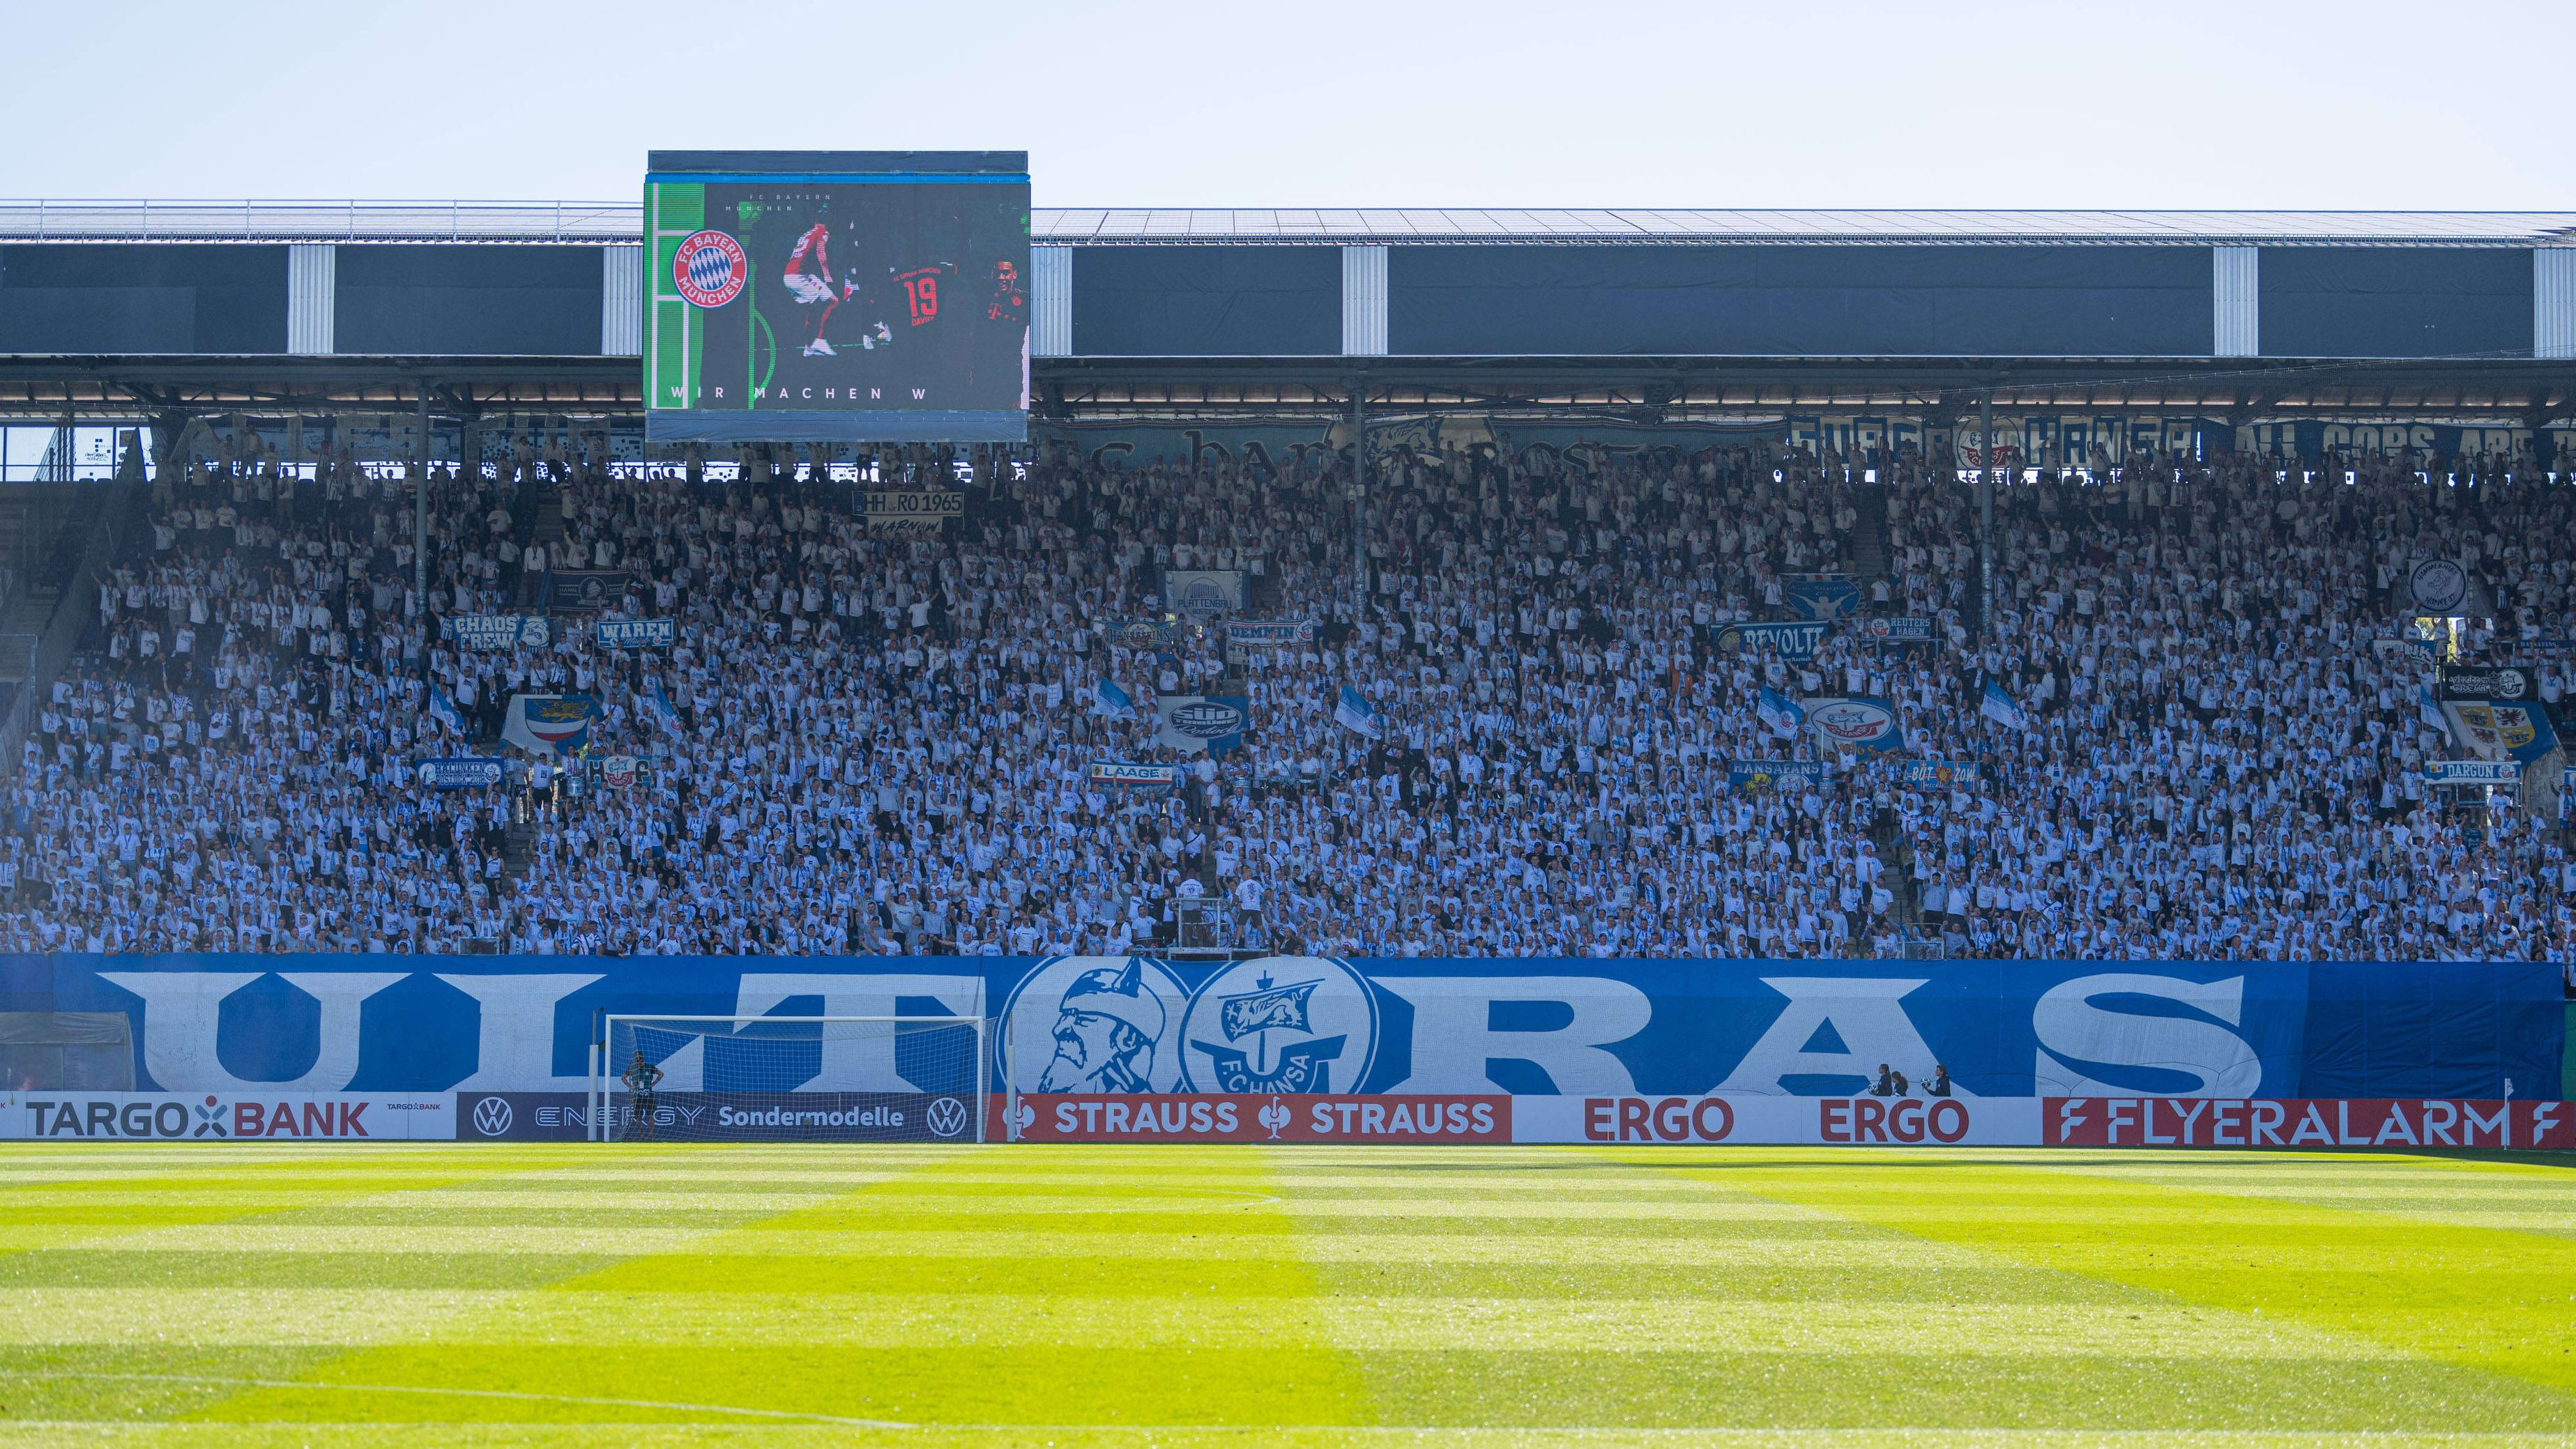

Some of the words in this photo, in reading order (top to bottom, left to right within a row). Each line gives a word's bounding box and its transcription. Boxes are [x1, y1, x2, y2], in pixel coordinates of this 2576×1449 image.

[678, 245, 694, 263] FC
[693, 234, 742, 263] BAYERN
[904, 276, 938, 317] 19
[671, 387, 724, 398] WIR
[754, 387, 881, 399] MACHEN
[911, 388, 926, 399] W
[2322, 424, 2436, 468] COPS
[864, 494, 886, 512] HH
[897, 494, 919, 512] RO
[922, 493, 962, 512] 1965
[1177, 598, 1233, 608] PLATTENBAU
[455, 616, 517, 633] CHAOS
[601, 622, 671, 638] WAREN
[1891, 617, 1930, 627] REUTERS
[1896, 627, 1925, 636] HAGEN
[460, 633, 515, 650] CREW
[1173, 707, 1237, 721] SÜD
[1172, 723, 1244, 737] Rostock
[434, 762, 486, 774] HALUNKEN
[1104, 767, 1159, 779] LAAGE
[2447, 764, 2494, 778] DARGUN
[535, 1105, 706, 1126] ENERGY
[719, 1105, 904, 1126] Sondermodelle
[1054, 1101, 1239, 1133] STRAUSS
[1311, 1103, 1495, 1135] STRAUSS
[1584, 1098, 1735, 1142] ERGO
[1820, 1099, 1970, 1142] ERGO
[2108, 1099, 2511, 1145] FLYERALARM
